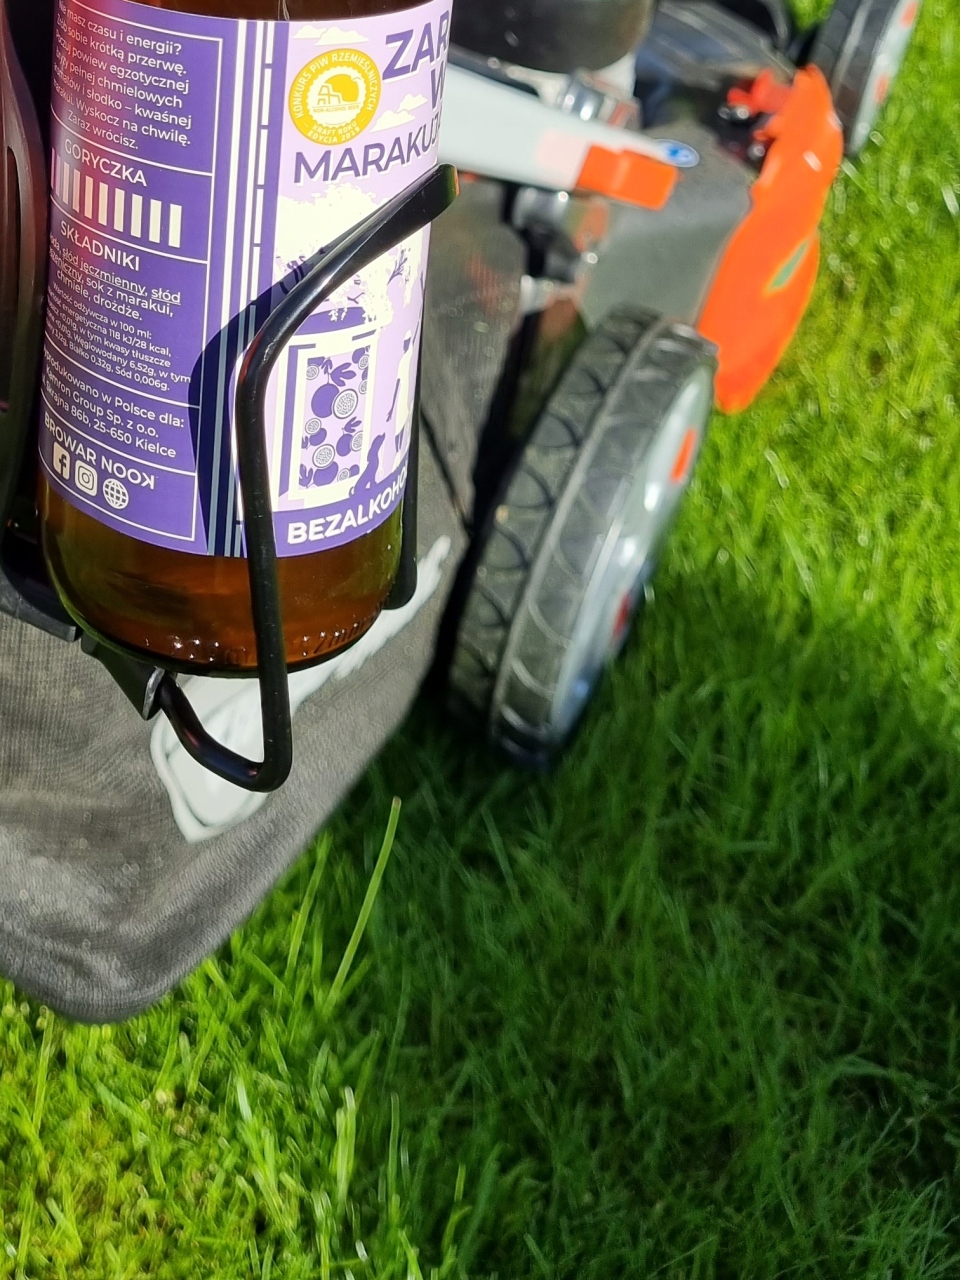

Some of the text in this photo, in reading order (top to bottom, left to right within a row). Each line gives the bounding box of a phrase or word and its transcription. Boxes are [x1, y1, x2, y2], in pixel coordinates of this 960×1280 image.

[67, 9, 86, 28] masz
[87, 21, 117, 40] czasu
[120, 29, 124, 42] i
[126, 35, 182, 55] energii?
[67, 26, 88, 45] sobie
[89, 36, 125, 62] krótką
[127, 52, 187, 77] przerwę.
[69, 62, 96, 86] pełnej
[97, 76, 183, 108] chmielowych
[72, 46, 108, 71] powiew
[109, 64, 190, 95] egzotycznej
[292, 52, 378, 119] KONKURS PIW RZEMIEŚLNICZYCH
[67, 109, 139, 150] Zaraz wrócisz.
[75, 97, 120, 127] Wyskocz
[122, 119, 138, 132] na
[141, 124, 191, 147] chwilę.
[86, 88, 123, 110] słodko
[134, 103, 192, 130] kwaśnej
[311, 120, 358, 136] KRAFT ROKU
[307, 126, 361, 144] EDYCJA 2019
[64, 138, 148, 187] GORYCZKA
[60, 220, 140, 272] SKŁADNIKI
[56, 269, 143, 321] chmiele, drożdże.
[62, 247, 79, 267] słód
[79, 257, 148, 297] jęczmienny,
[151, 287, 181, 305] słód
[86, 277, 105, 294] sok
[106, 286, 114, 297] z
[116, 292, 174, 318] marakui,
[62, 303, 108, 335] energetyczna
[109, 328, 121, 340] 118
[122, 334, 147, 350] kJ/28
[149, 342, 172, 358] kcal,
[73, 300, 109, 324] odżywcza
[110, 319, 119, 328] w
[119, 321, 135, 334] 100
[136, 329, 152, 340] ml:
[69, 340, 89, 360] Białko
[115, 366, 132, 380] Sód
[134, 373, 170, 392] 0,006g.
[73, 332, 129, 368] Węglowodany
[159, 370, 169, 379] w
[170, 372, 191, 384] tym
[79, 326, 87, 335] w
[87, 330, 102, 344] tym
[103, 337, 130, 357] kwasy
[131, 349, 172, 368] tłuszcze
[70, 405, 92, 428] 86b,
[93, 418, 133, 445] 25-650
[135, 436, 177, 458] Kielce
[72, 390, 104, 418] Group
[106, 409, 124, 426] Sp.
[126, 420, 134, 430] z
[136, 423, 159, 438] o.o.
[101, 392, 112, 404] w
[114, 397, 156, 421] Polsce
[158, 413, 185, 428] dla:
[44, 411, 156, 490] BROWAR NOOK
